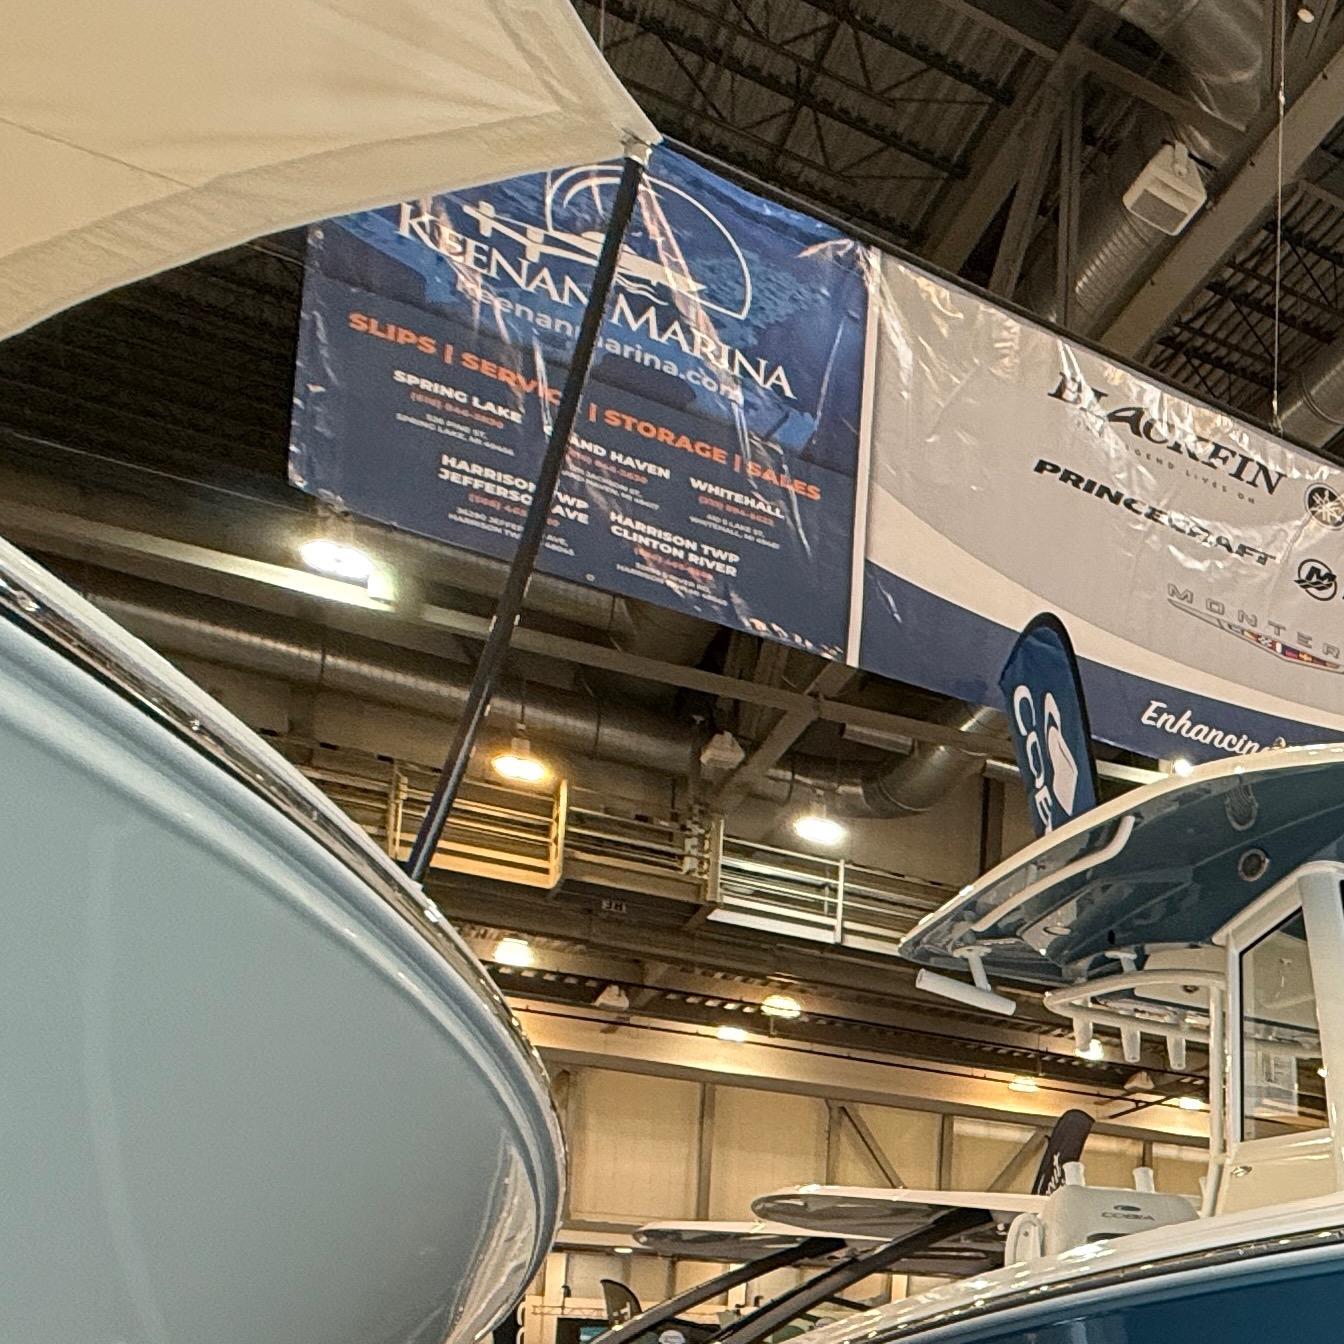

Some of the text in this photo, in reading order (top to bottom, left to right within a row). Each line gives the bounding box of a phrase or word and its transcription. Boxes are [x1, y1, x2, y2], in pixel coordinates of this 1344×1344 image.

[611, 293, 797, 400] MARINA
[349, 312, 438, 354] SLIPS
[461, 352, 564, 407] SERVIC
[604, 409, 728, 465] STORAGE
[746, 462, 821, 501] SALES
[393, 369, 468, 404] SPRING
[472, 395, 524, 424] LAKE
[610, 450, 671, 480] HAVEN
[551, 504, 589, 525] AVE
[689, 476, 784, 520] WHITEHALL
[1033, 459, 1277, 566] PRINCECRAFT
[610, 511, 699, 551] HARRISON
[701, 543, 740, 563] TWP
[610, 525, 685, 559] CLINTON
[688, 552, 738, 577] RIVER
[1141, 700, 1268, 755] Enhancin
